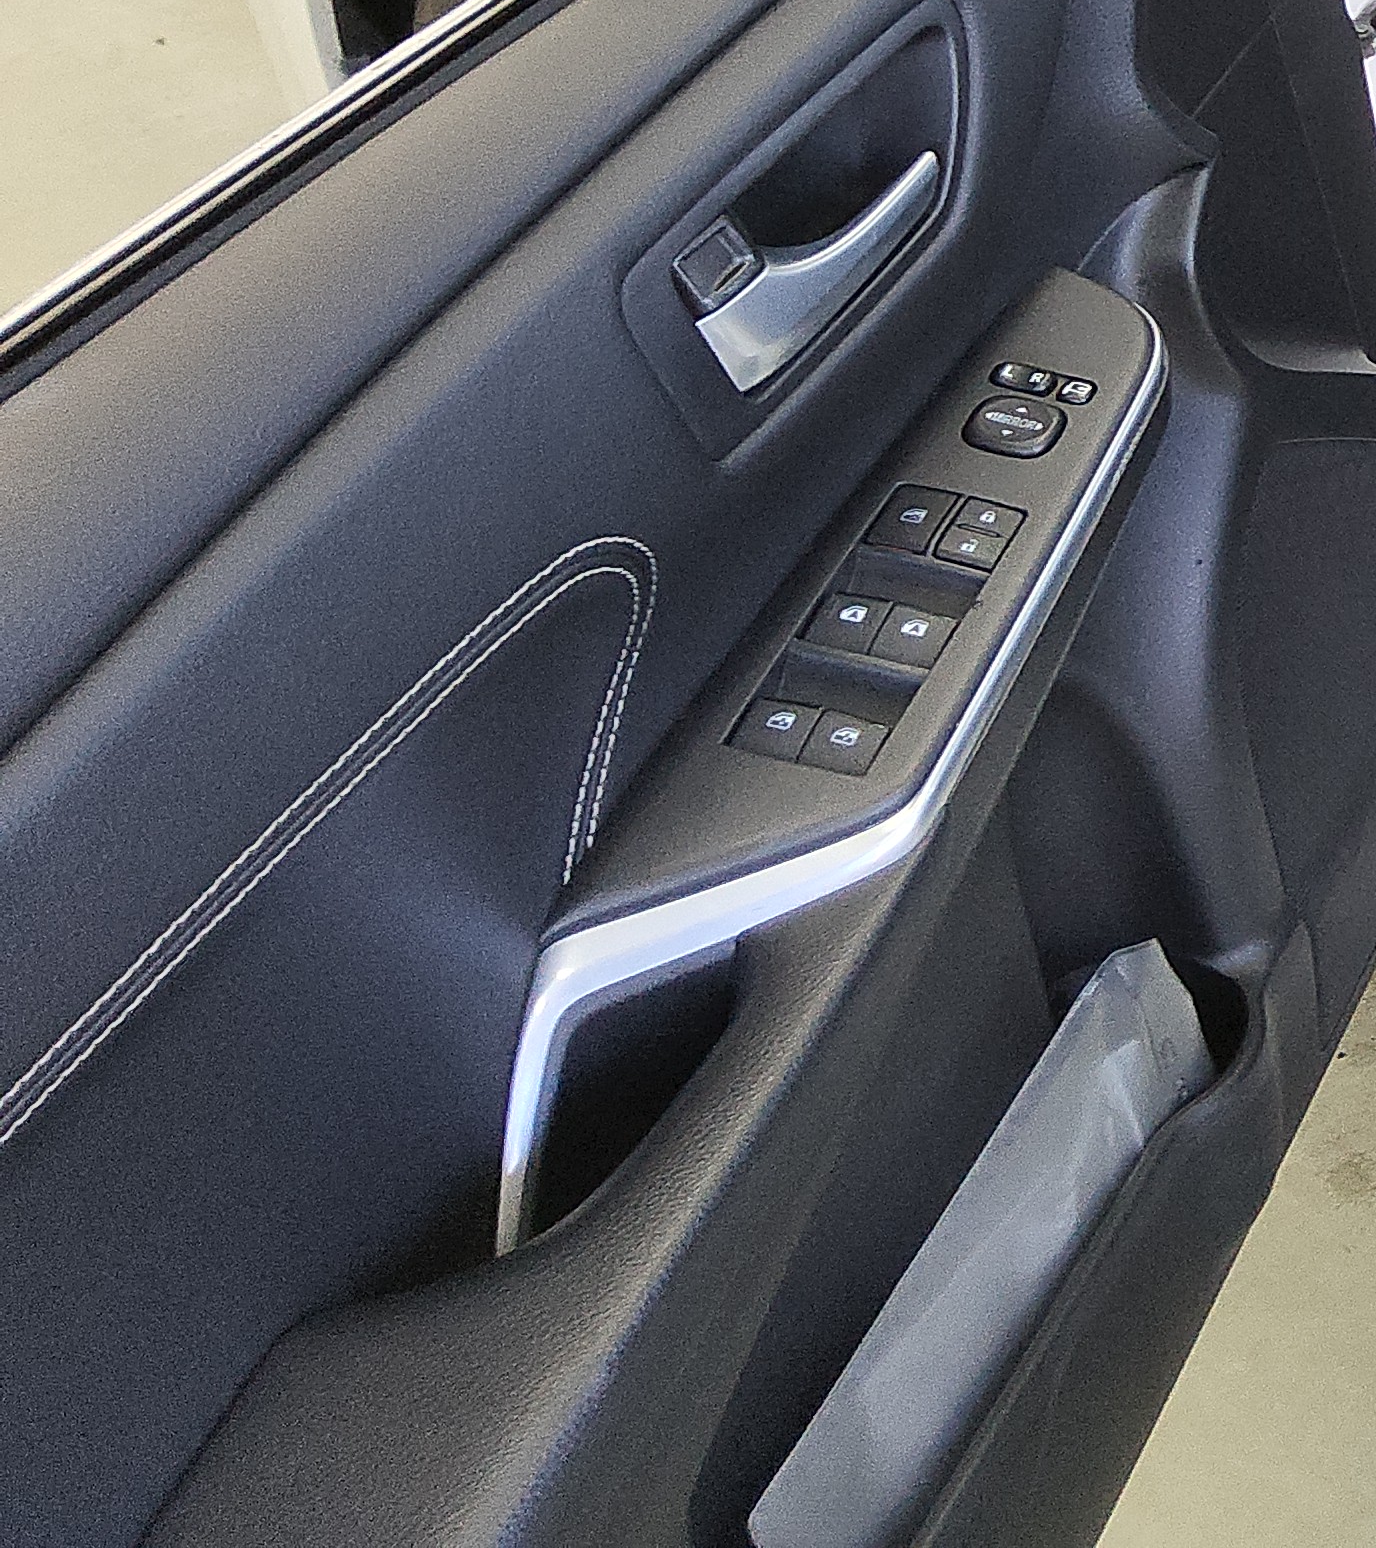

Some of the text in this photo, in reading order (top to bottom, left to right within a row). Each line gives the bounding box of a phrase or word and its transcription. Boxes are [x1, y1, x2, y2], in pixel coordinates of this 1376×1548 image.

[1000, 363, 1044, 383] L R
[989, 410, 1038, 431] MIRROR
